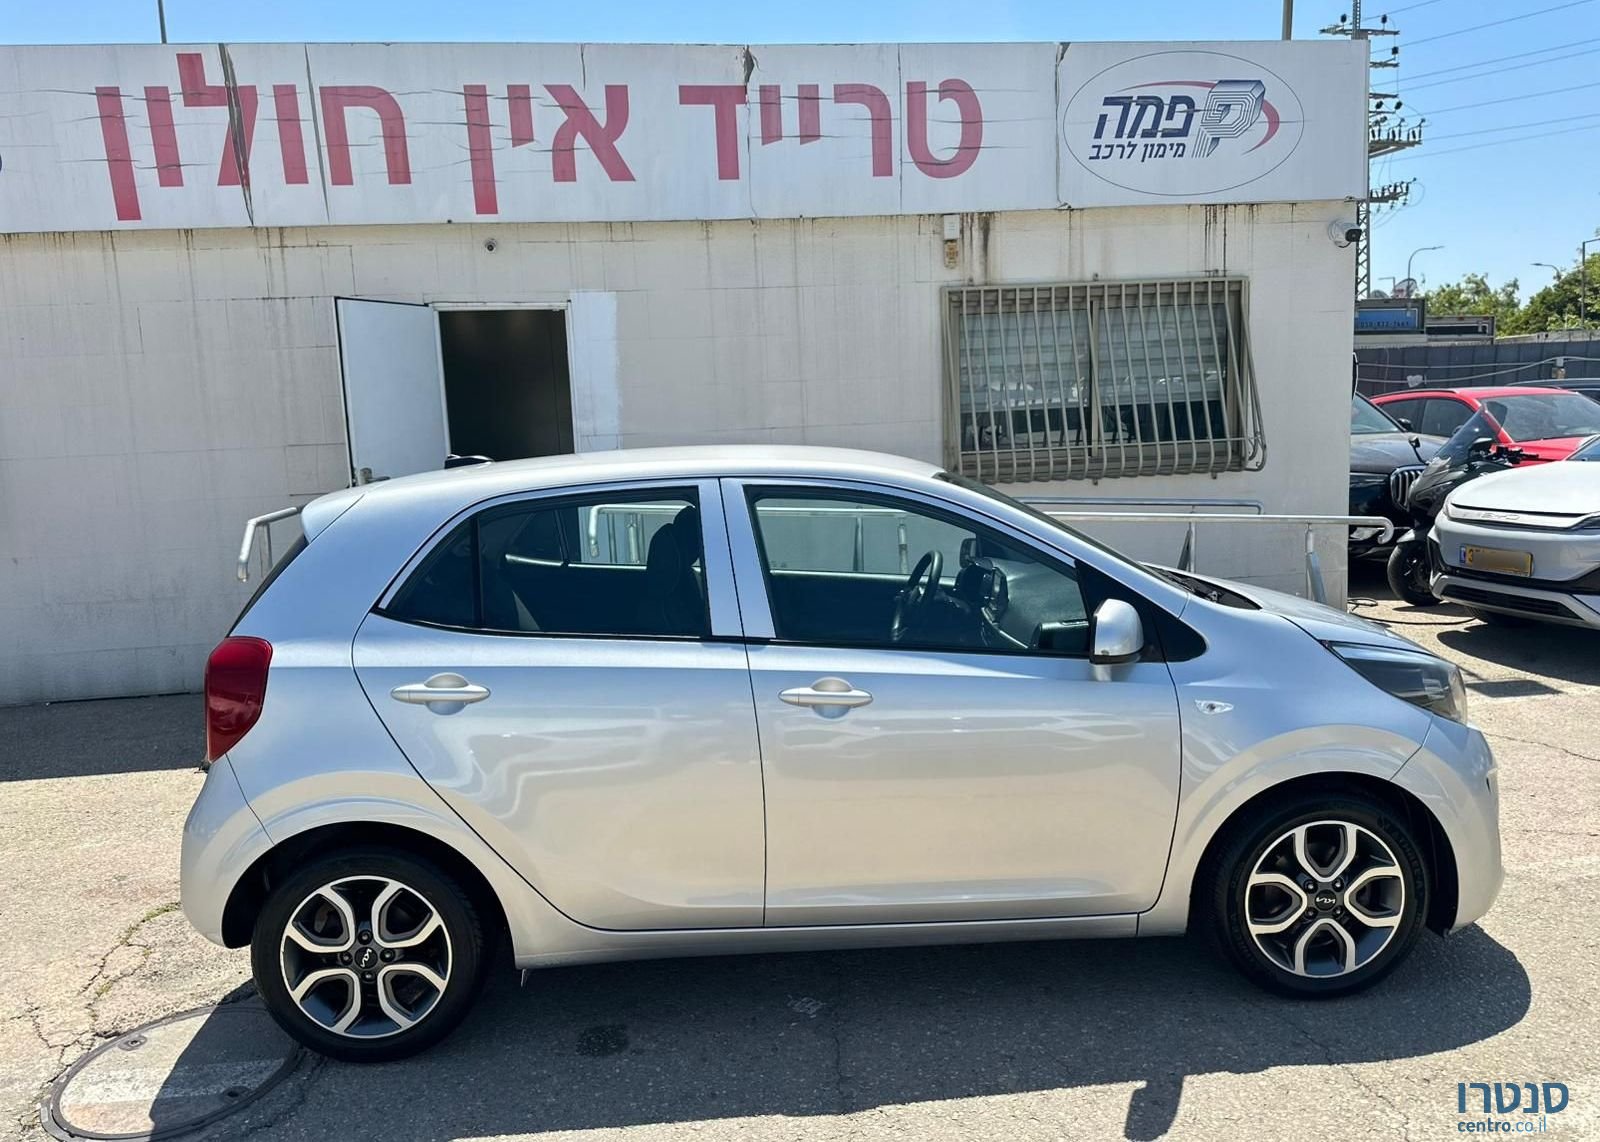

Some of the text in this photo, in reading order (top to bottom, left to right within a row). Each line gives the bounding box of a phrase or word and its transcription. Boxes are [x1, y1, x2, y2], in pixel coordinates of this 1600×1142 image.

[95, 53, 984, 221] טרייד אין חולון
[1093, 95, 1196, 140] פמה
[1088, 140, 1187, 163] מימון לרכב
